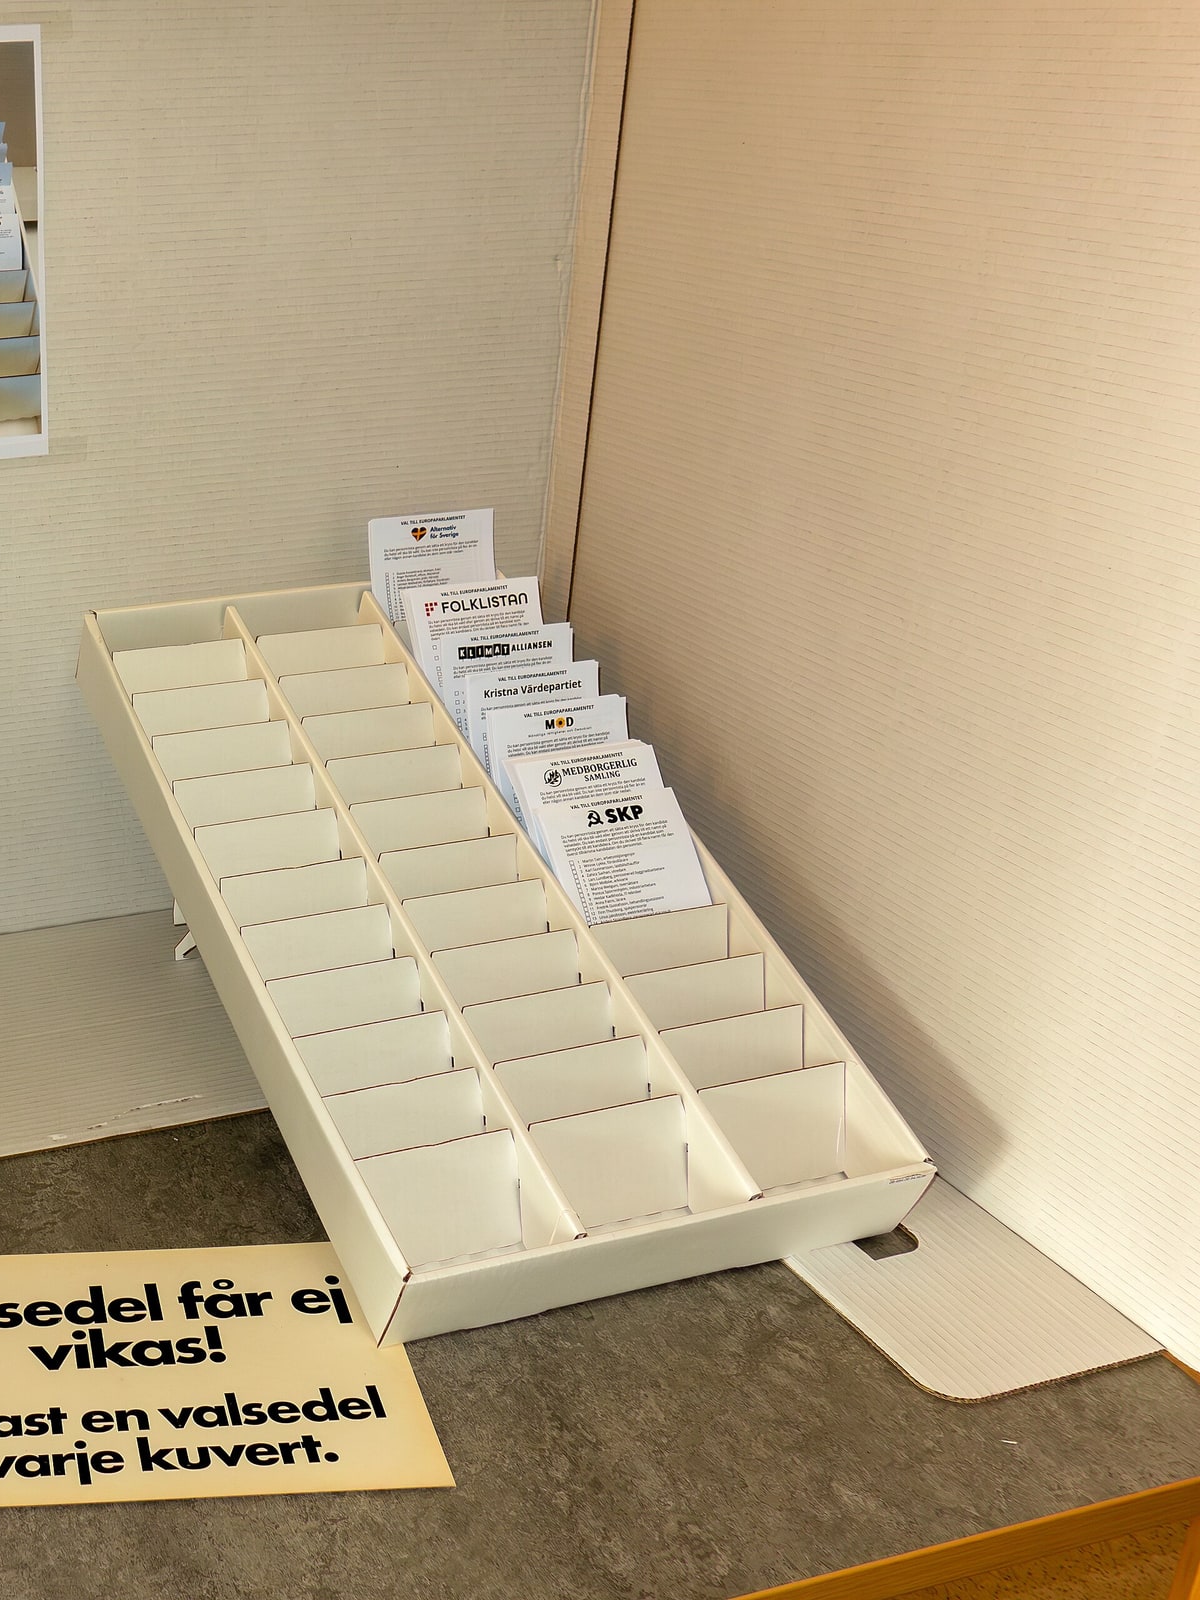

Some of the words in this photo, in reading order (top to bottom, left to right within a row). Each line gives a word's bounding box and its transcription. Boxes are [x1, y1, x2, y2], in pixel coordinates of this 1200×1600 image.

[418, 515, 465, 523] EUROPAPARLAMENTET
[430, 524, 456, 533] Alternativ
[439, 531, 459, 540] Sverige
[459, 584, 507, 594] EUROPAPARLAMENTET
[442, 592, 528, 614] FOLKLISTAN
[489, 630, 539, 639] EUROPAPARLAMENTET
[517, 669, 566, 679] EUROPAPARLAMENTET
[484, 684, 518, 698] Kristna
[520, 680, 582, 696] Värdepartiet
[543, 704, 594, 715] EUROPAPARLAMENTET
[570, 752, 623, 763] EUROPAPARLAMENTET
[562, 758, 637, 776] MEDBORGERLIG
[585, 771, 621, 782] SAMLING
[590, 795, 642, 806] EUROPAPARLAMENTET
[604, 804, 643, 823] SKP
[177, 1278, 274, 1323] får
[290, 1275, 354, 1324] ej
[28, 1326, 227, 1371] vikas!
[81, 1407, 149, 1434] en
[158, 1384, 386, 1429] valsedel
[136, 1434, 340, 1474] kuvert.
